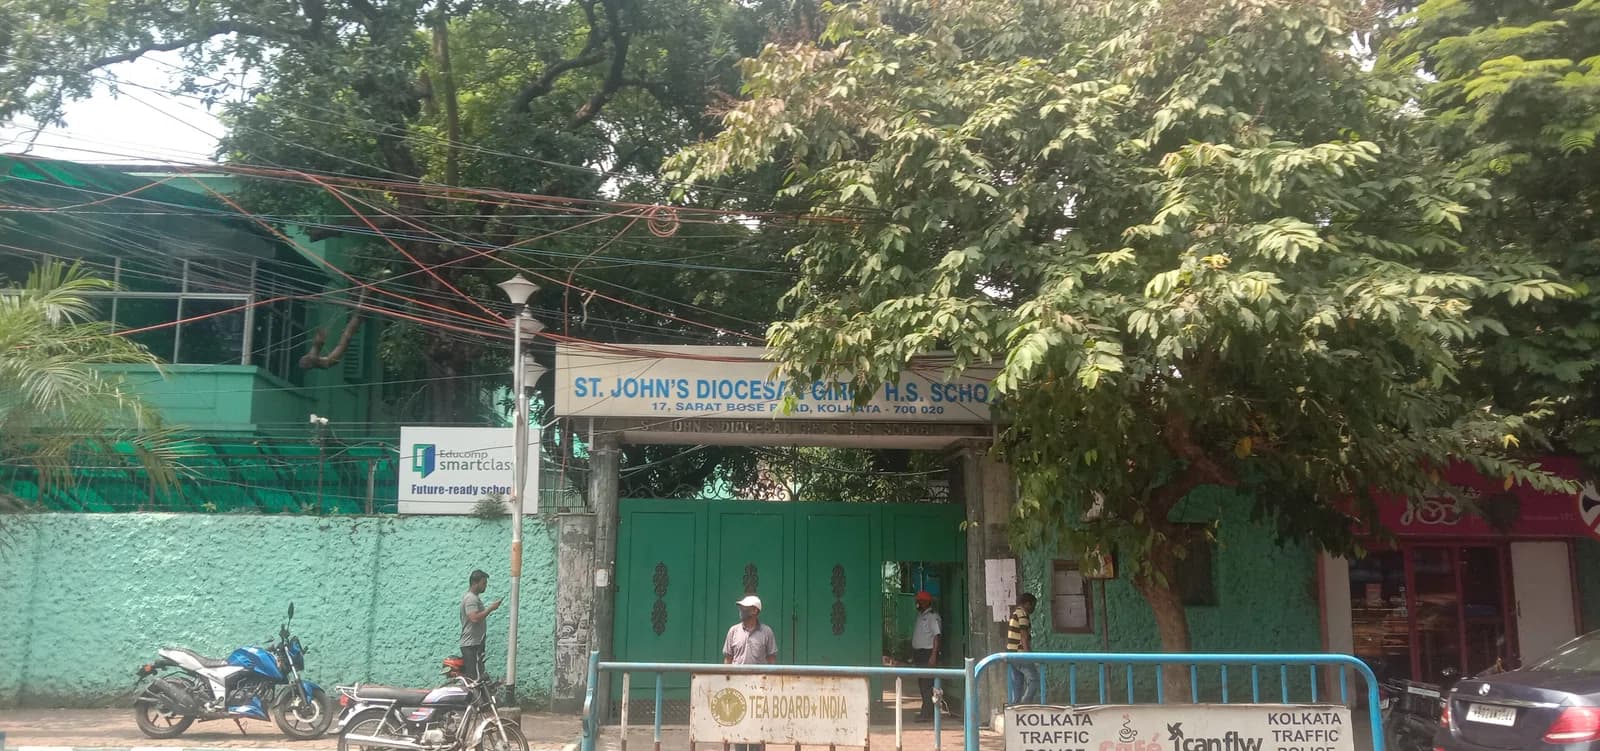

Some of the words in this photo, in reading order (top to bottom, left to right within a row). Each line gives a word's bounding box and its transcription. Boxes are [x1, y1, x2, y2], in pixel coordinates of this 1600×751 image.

[574, 377, 603, 398] ST.
[611, 378, 690, 399] JOHN'S
[697, 379, 804, 401] DIOCESA
[885, 382, 924, 402] H.S.
[930, 383, 990, 403] SCHO
[652, 402, 671, 412] 17,
[676, 402, 721, 412] SARAT
[727, 403, 765, 412] BOSE
[770, 403, 813, 413] RAD,
[894, 405, 917, 414] 700
[921, 406, 944, 415] 020
[440, 449, 488, 460] Educomp
[411, 484, 479, 496] Future-ready
[480, 484, 513, 496] schoo
[749, 695, 770, 719] TEA
[772, 695, 811, 719] BOARD
[819, 695, 849, 720] INDIA
[1016, 713, 1094, 727] KOLKATA
[1267, 712, 1343, 726] KOLKATA
[1019, 731, 1090, 744] TRAFFIC
[1271, 729, 1340, 743] TRAFFIC
